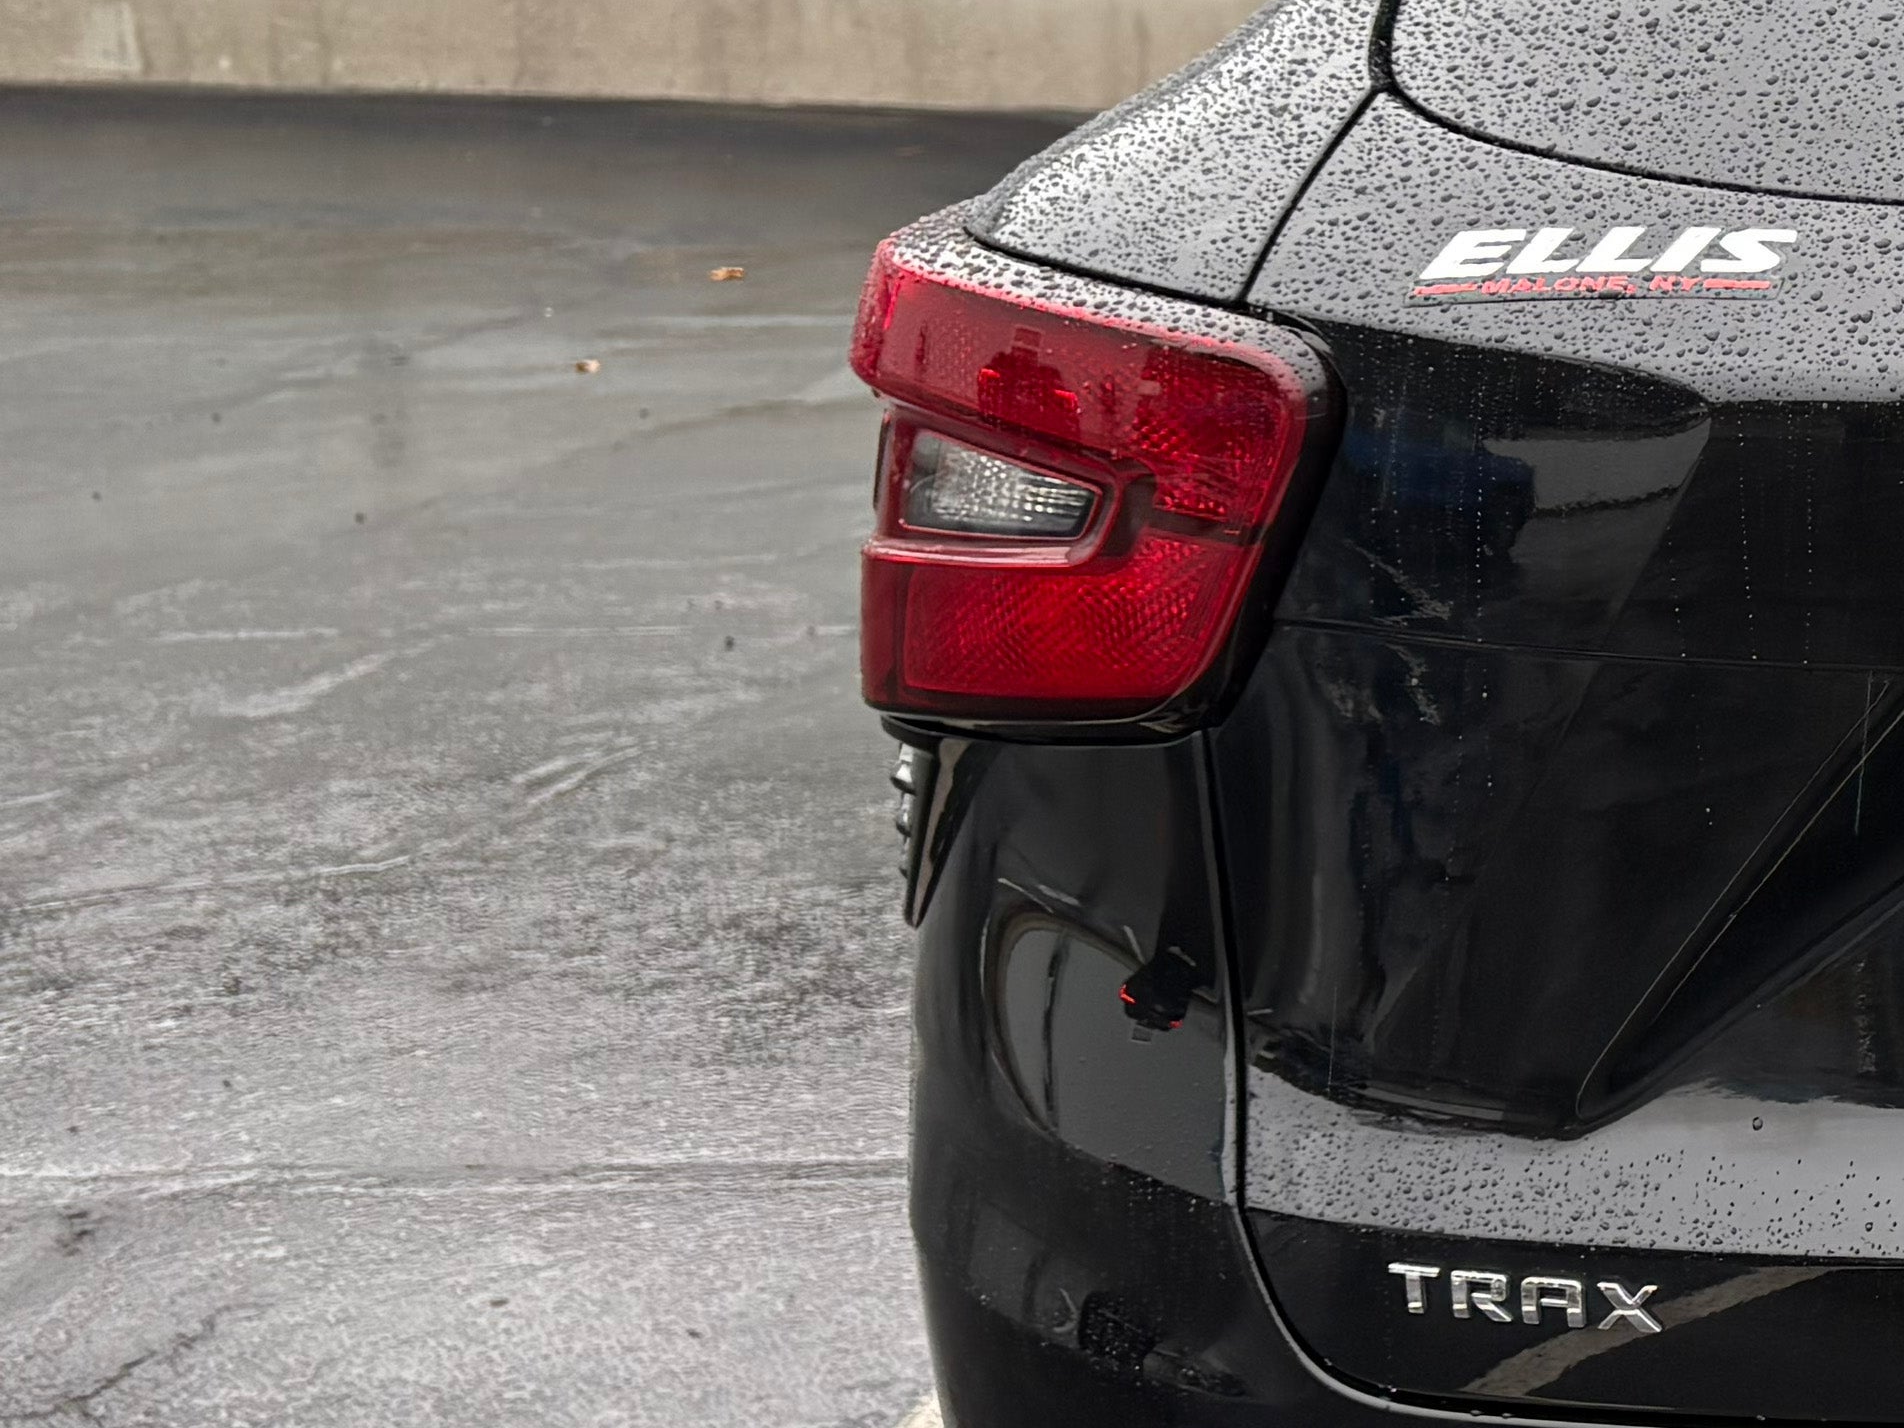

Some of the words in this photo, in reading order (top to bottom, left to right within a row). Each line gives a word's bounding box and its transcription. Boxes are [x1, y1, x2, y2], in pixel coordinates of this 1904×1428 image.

[1418, 225, 1798, 280] ELLIS
[1480, 275, 1638, 295] MALONE,
[1650, 274, 1704, 293] NY
[1387, 1261, 1663, 1333] TRAX
